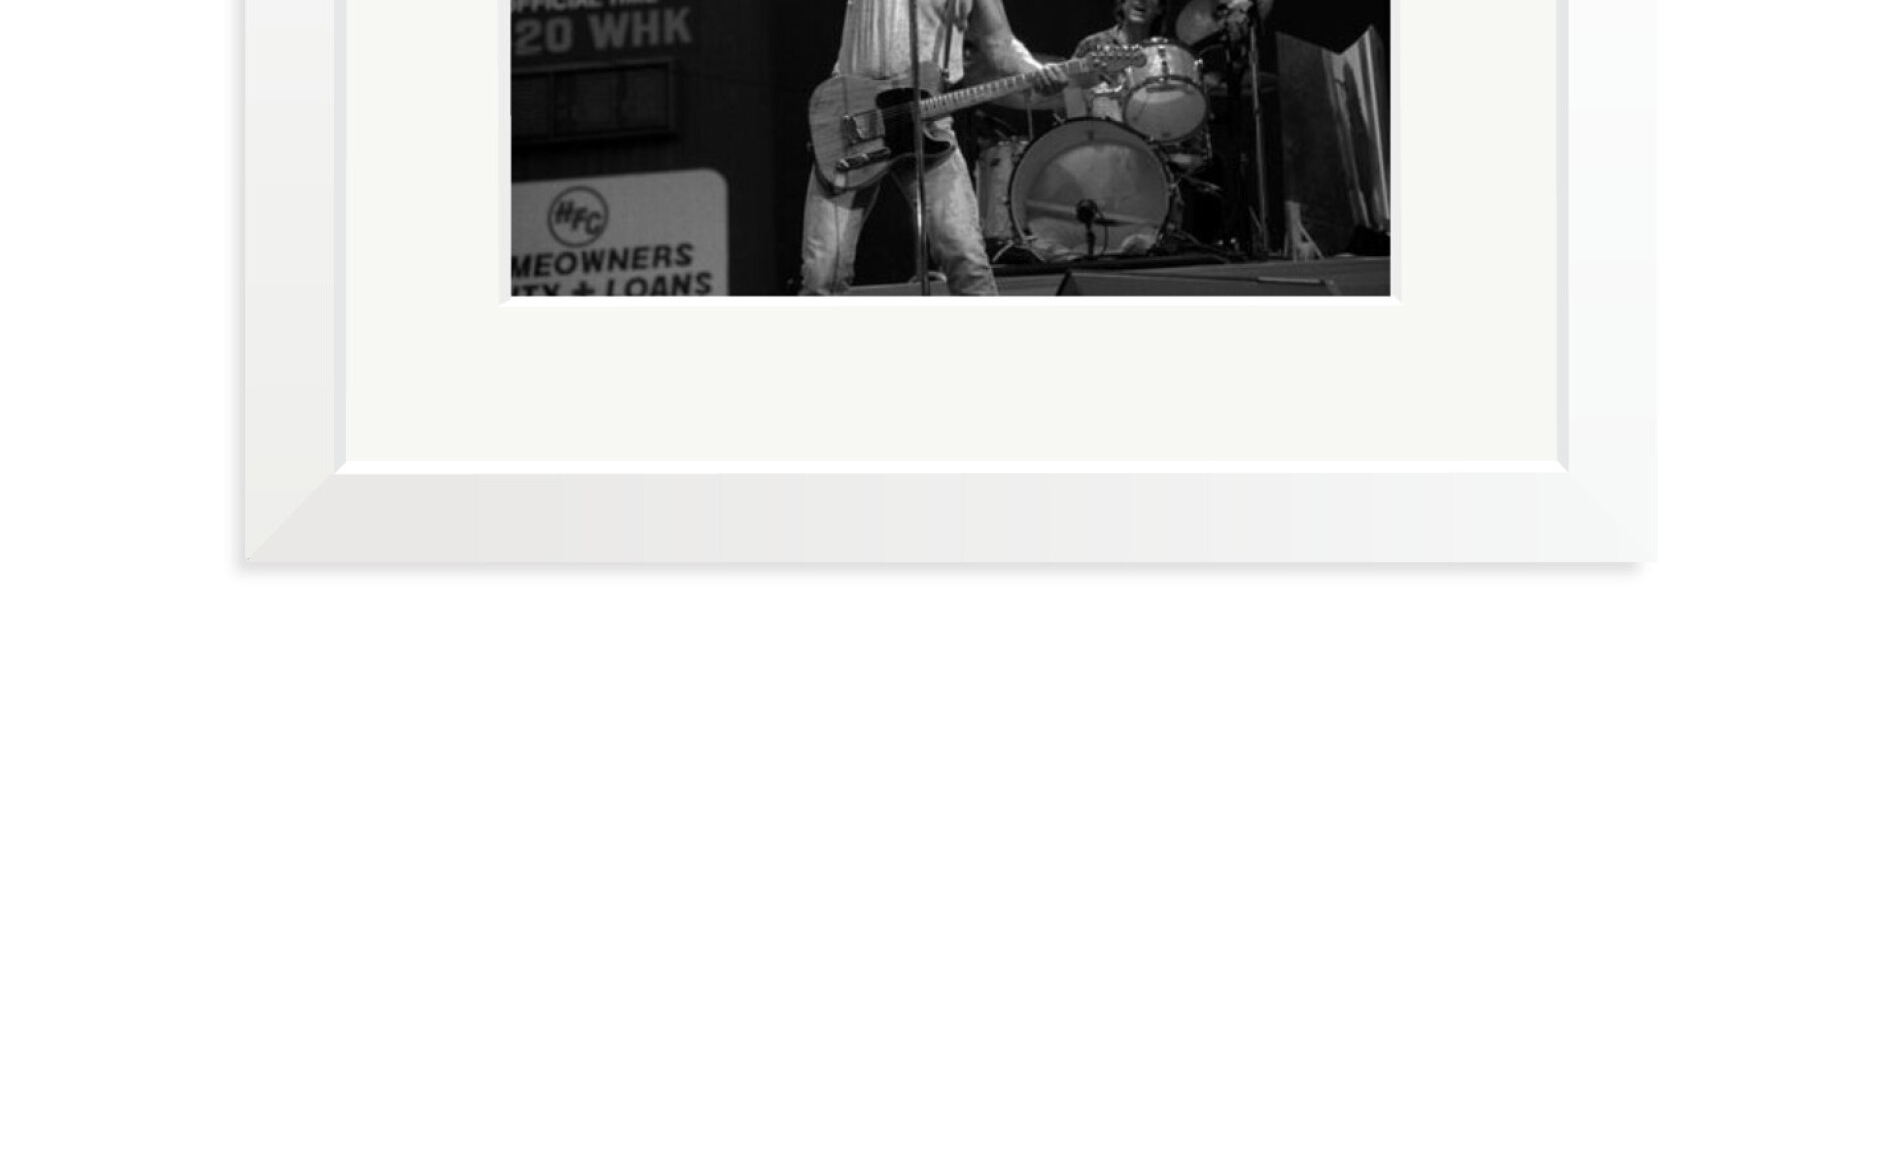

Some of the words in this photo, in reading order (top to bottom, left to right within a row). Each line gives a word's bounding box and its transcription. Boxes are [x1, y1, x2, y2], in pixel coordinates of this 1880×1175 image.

[588, 6, 692, 50] WHK
[555, 198, 602, 236] HFC
[607, 272, 713, 296] LOANS
